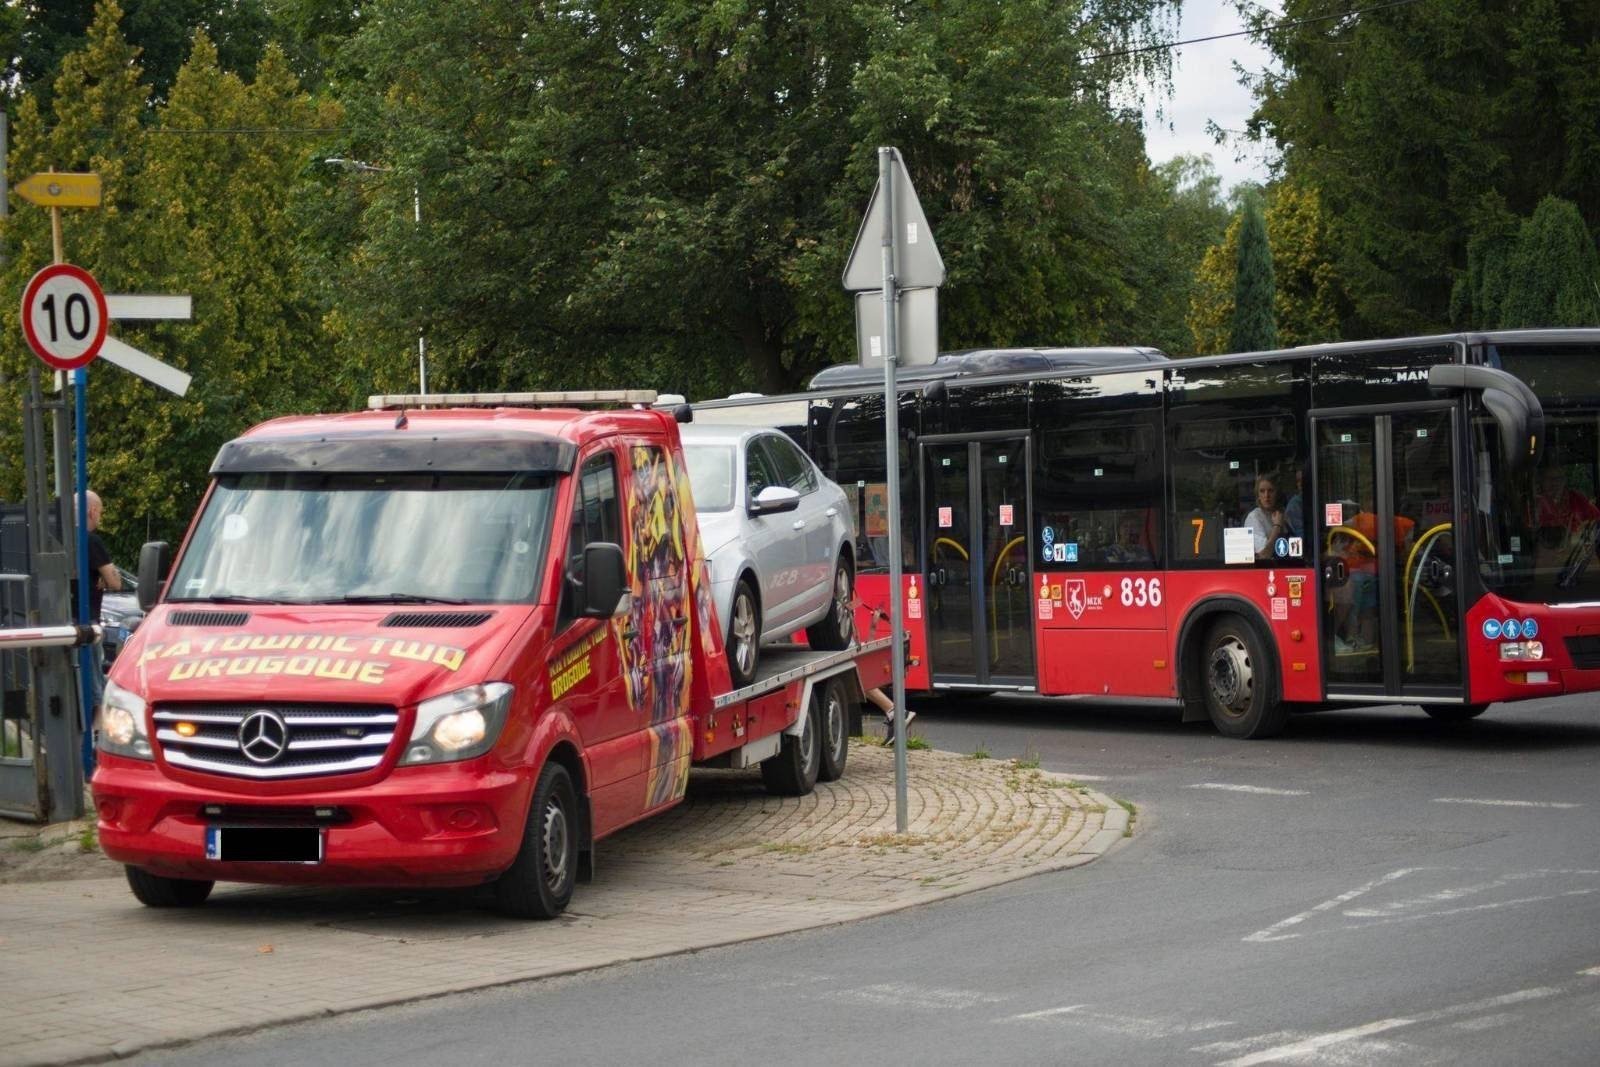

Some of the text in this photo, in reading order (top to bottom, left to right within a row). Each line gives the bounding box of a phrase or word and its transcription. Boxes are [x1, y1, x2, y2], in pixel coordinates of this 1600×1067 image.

[41, 293, 91, 342] 10
[1396, 370, 1429, 382] MAN
[1191, 519, 1204, 554] 7
[1086, 597, 1103, 606] MZK
[1120, 577, 1162, 607] 836
[167, 654, 391, 685] DROGOWE
[552, 654, 592, 701] DROGOWE
